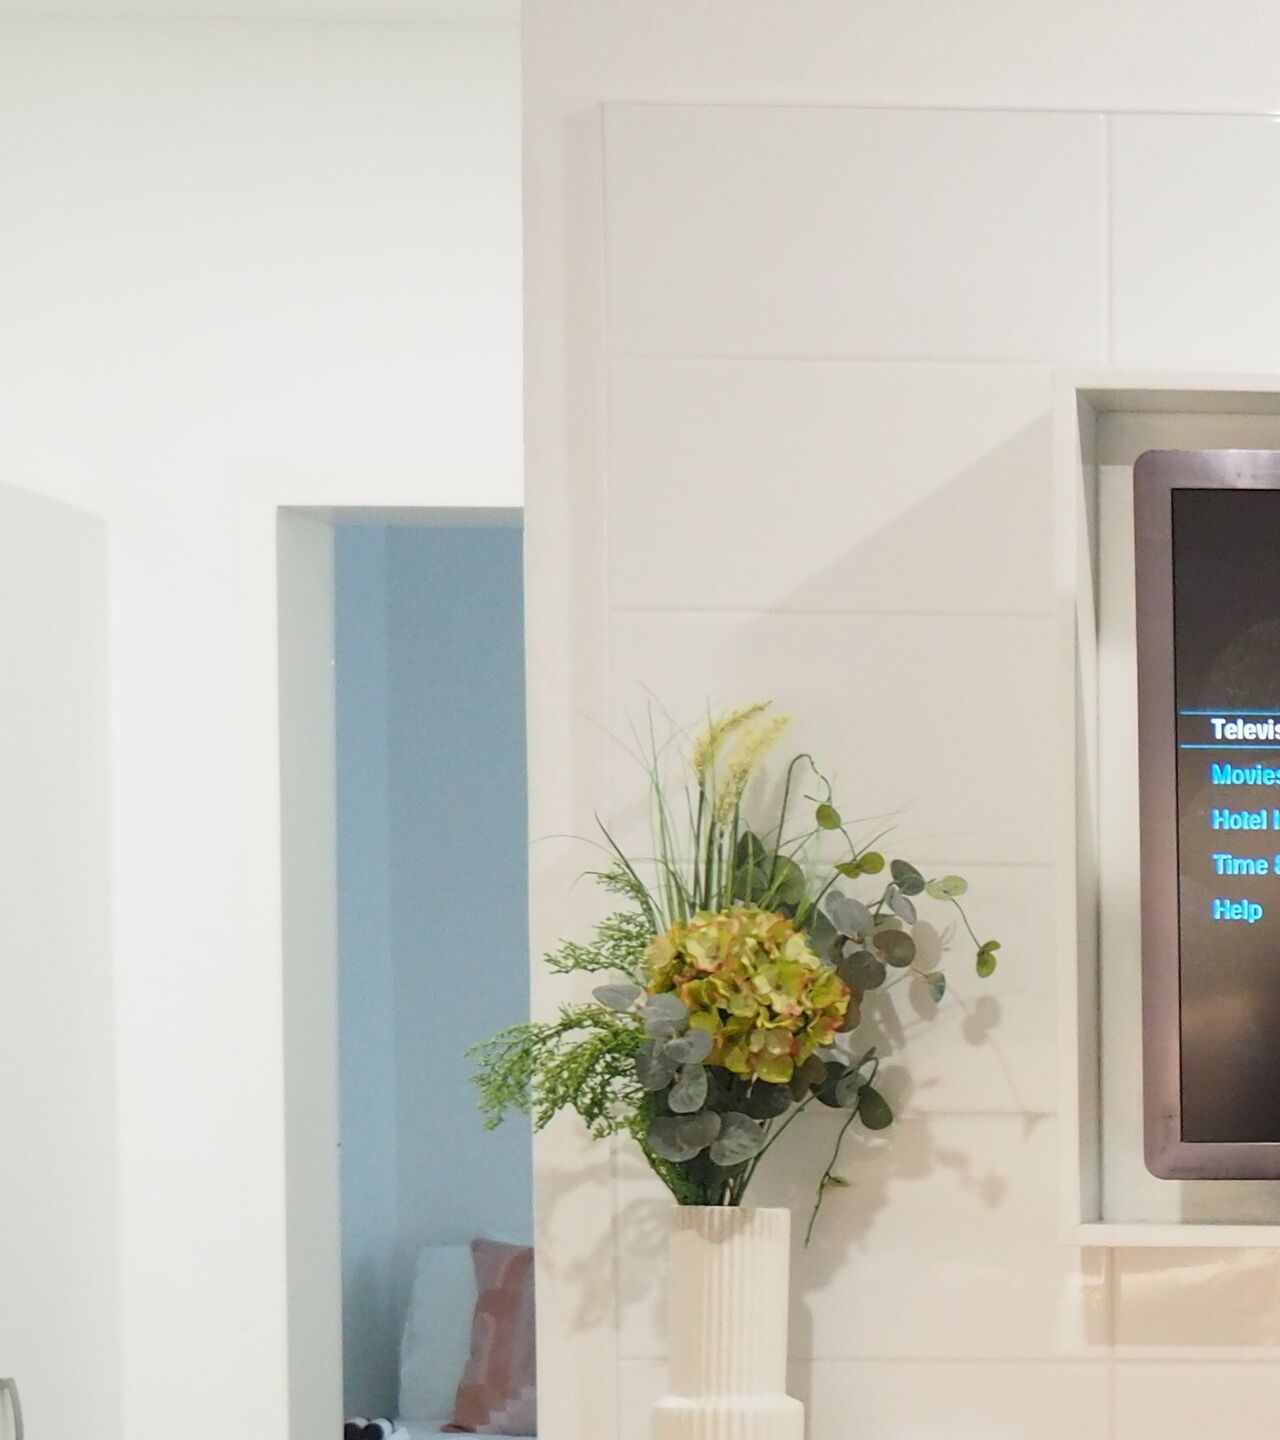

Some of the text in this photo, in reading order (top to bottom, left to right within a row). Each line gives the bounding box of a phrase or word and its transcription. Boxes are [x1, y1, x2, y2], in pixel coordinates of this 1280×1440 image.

[1211, 809, 1268, 830] Hotel
[1212, 854, 1269, 875] Time
[1212, 899, 1263, 923] Help
